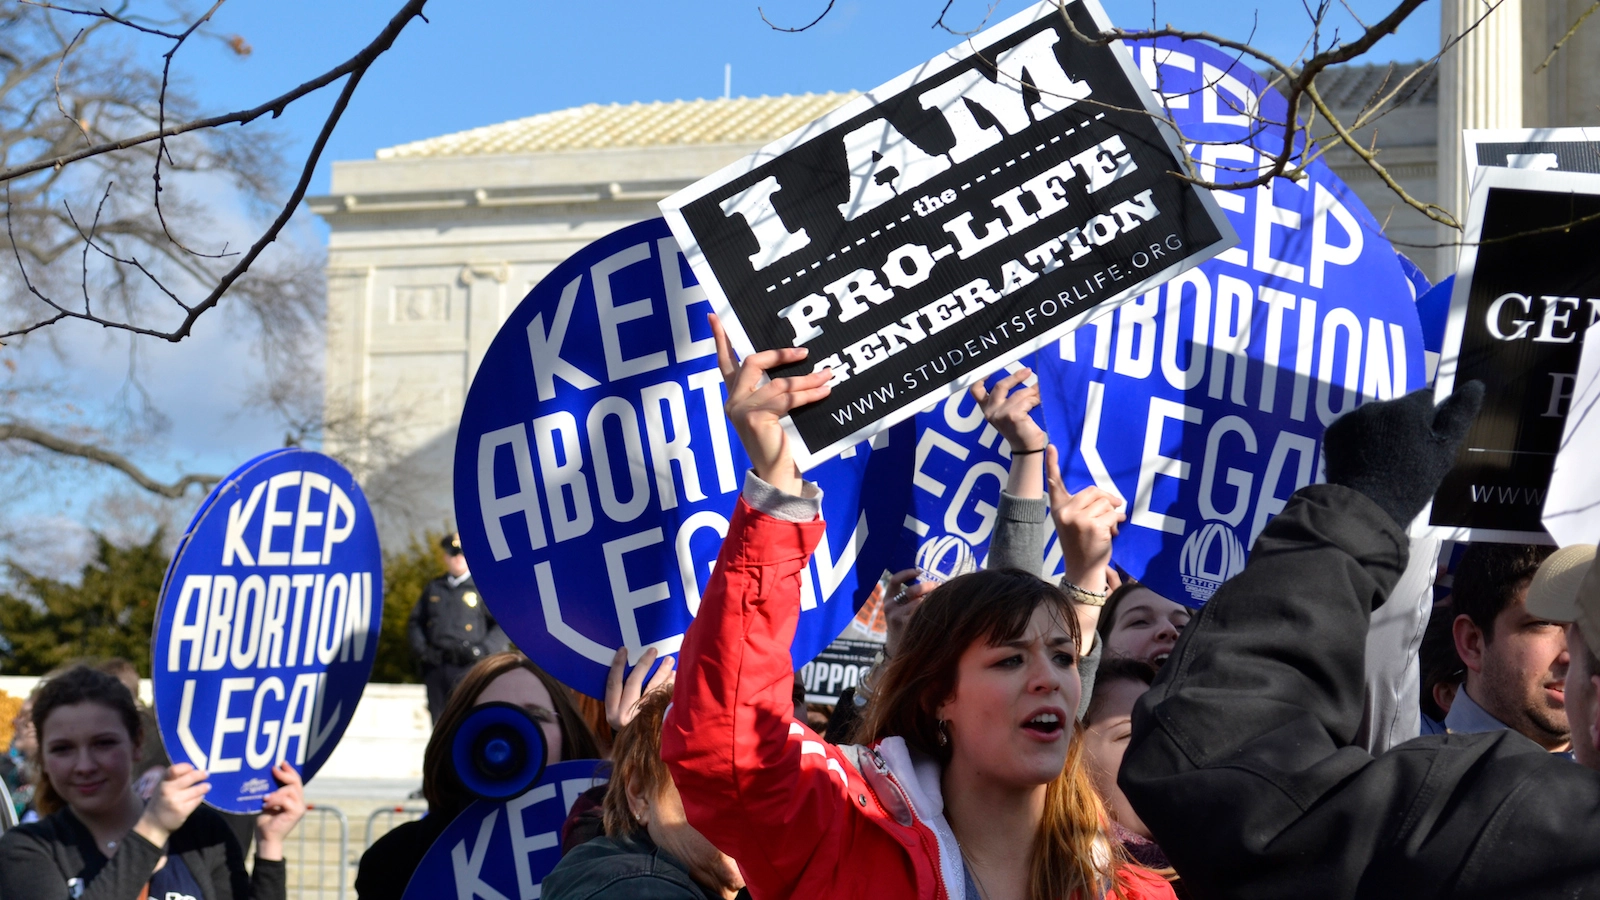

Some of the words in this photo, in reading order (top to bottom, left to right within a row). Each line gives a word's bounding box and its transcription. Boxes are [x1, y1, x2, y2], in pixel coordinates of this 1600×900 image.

[719, 176, 811, 271] I
[837, 27, 1092, 221] AM
[912, 186, 957, 217] the
[1186, 141, 1364, 289] EEP
[526, 237, 717, 402] KEE
[777, 135, 1139, 346] PRO-LIFE
[811, 188, 1160, 389] GENERATION
[830, 233, 1183, 426] WWW.STUDENTSFORLIFE.ORG
[221, 470, 356, 567] KEEP
[478, 367, 740, 562] ABORT
[1079, 381, 1327, 552] LEGA
[167, 572, 372, 672] ABORTION
[533, 481, 869, 668] LEGL
[1179, 523, 1246, 582] NOW
[176, 672, 342, 774] LEGAL
[451, 778, 608, 900] KE
